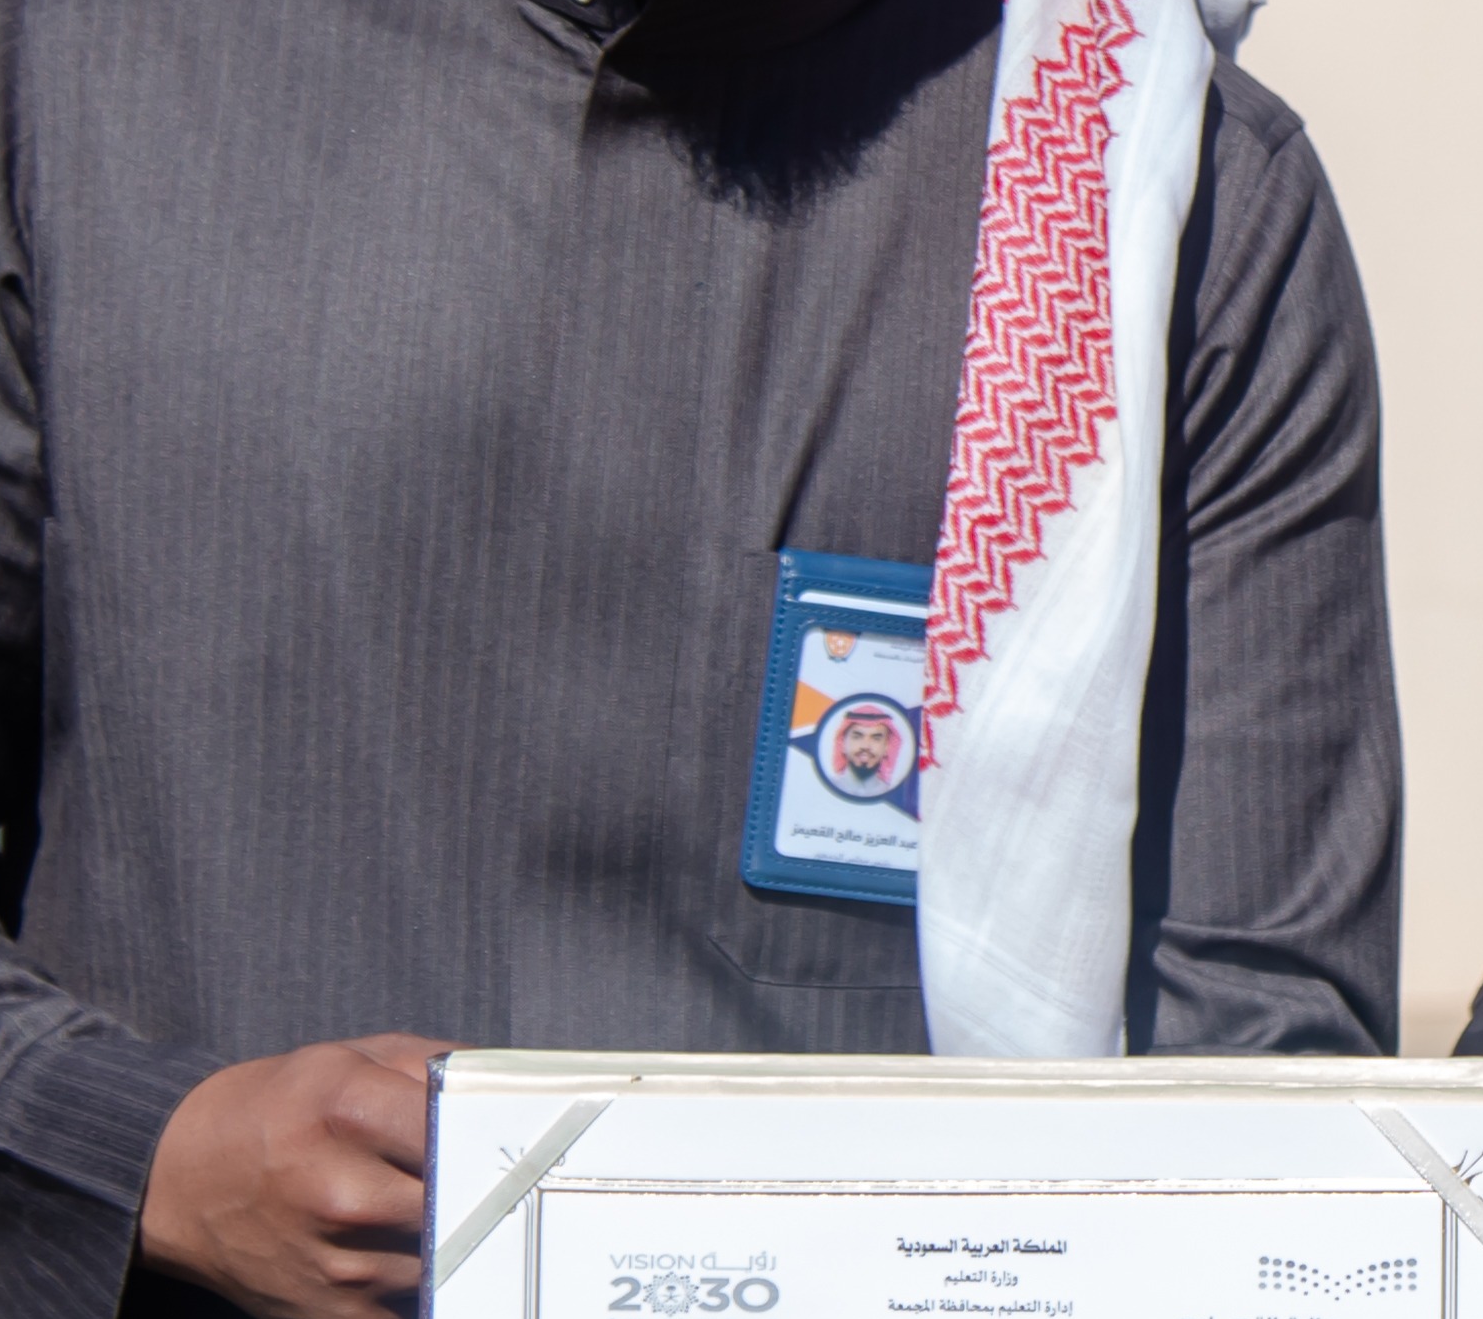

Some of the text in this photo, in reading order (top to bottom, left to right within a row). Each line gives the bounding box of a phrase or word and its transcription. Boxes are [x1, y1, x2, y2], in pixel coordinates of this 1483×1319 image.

[836, 829, 863, 843] صالح
[897, 1237, 1067, 1257] المملكة العربية السعودية
[609, 1253, 696, 1270] VISION
[944, 1270, 1018, 1286] وزارة التعليم
[888, 1298, 1073, 1317] إدارة التعليم بمحافظة المجمعة
